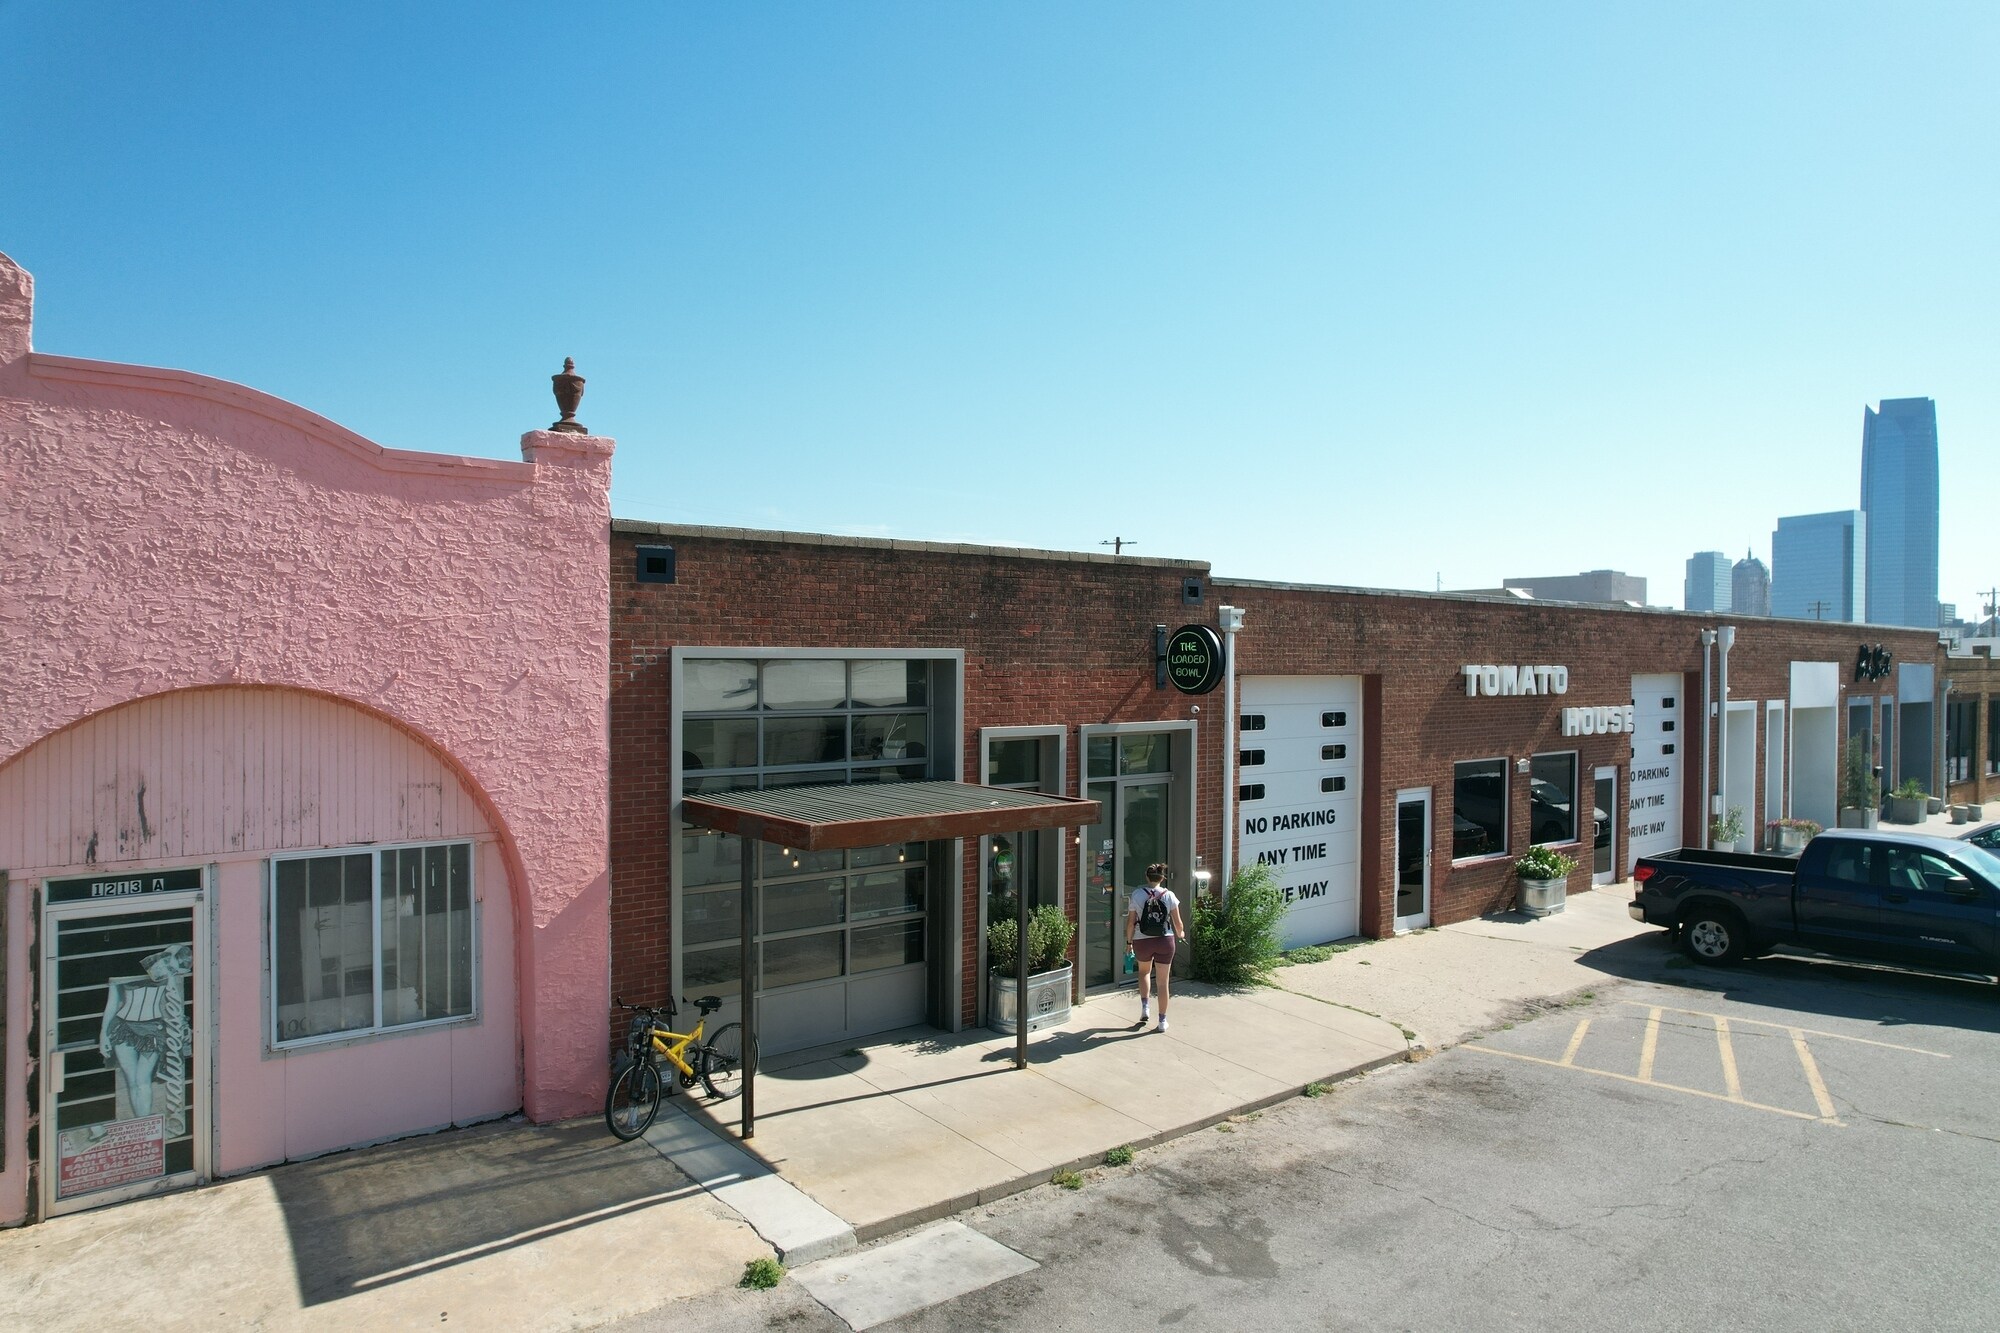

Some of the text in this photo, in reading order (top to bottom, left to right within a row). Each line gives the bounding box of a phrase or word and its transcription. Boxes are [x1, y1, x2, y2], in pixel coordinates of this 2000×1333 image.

[1180, 642, 1197, 651] THE
[1171, 655, 1205, 664] LOADED
[1176, 668, 1201, 678] BOWL
[1461, 664, 1568, 697] TOMATO
[1561, 705, 1635, 737] HOUSE
[1630, 767, 1670, 782] O PARKING
[1630, 794, 1665, 810] ANY TIME
[1245, 809, 1336, 835] NO PARKING
[1629, 821, 1666, 838] RIVE WAY
[1257, 843, 1327, 866] ANY TIME
[94, 879, 163, 896] 1213 A
[1298, 880, 1329, 900] WAY
[1920, 935, 1956, 944] TUNDRA
[126, 1120, 160, 1130] VEHICLES
[113, 1138, 145, 1147] EXPENSE
[129, 1130, 159, 1139] VEHICLE
[64, 1147, 160, 1172] EAGLE TOWING
[74, 1142, 152, 1163] AMERICAN
